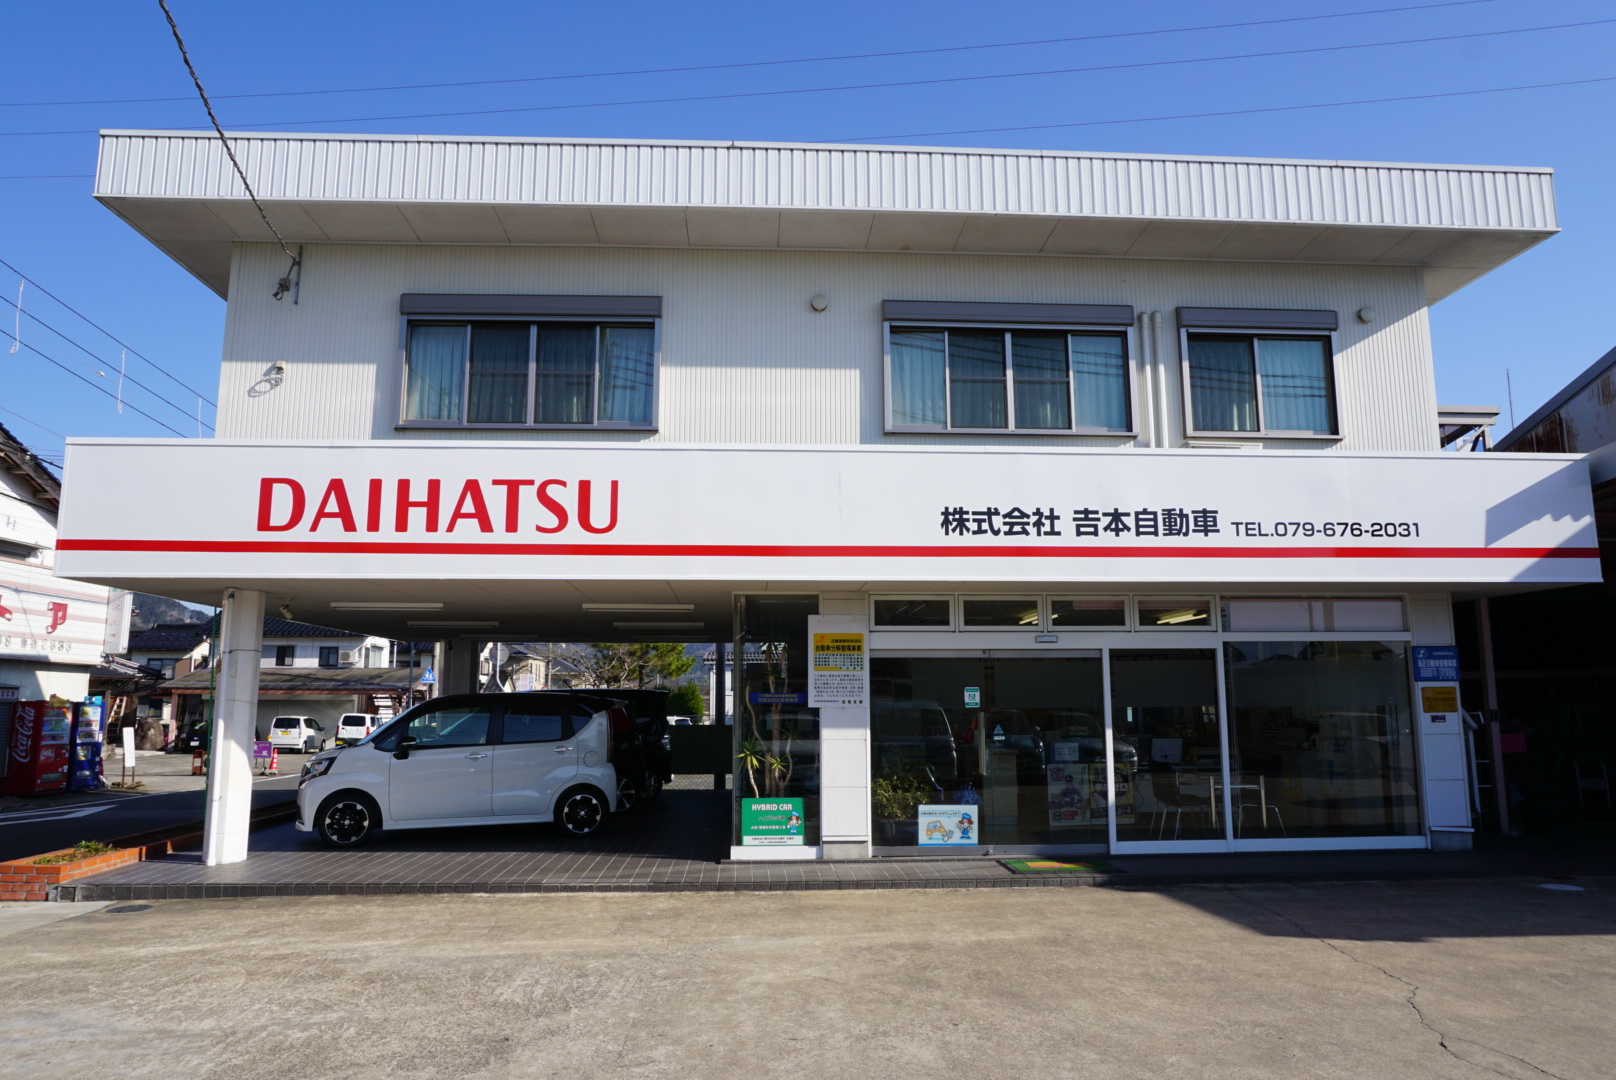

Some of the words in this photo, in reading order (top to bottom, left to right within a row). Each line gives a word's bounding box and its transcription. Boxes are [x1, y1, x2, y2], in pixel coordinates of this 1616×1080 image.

[257, 478, 618, 534] DAIHATSU
[940, 507, 1061, 537] 株式会社
[1072, 508, 1220, 537] 吉本自動車
[1231, 521, 1420, 538] TEL.079-676-2031
[751, 803, 778, 811] HYBRID
[779, 803, 793, 811] CAR
